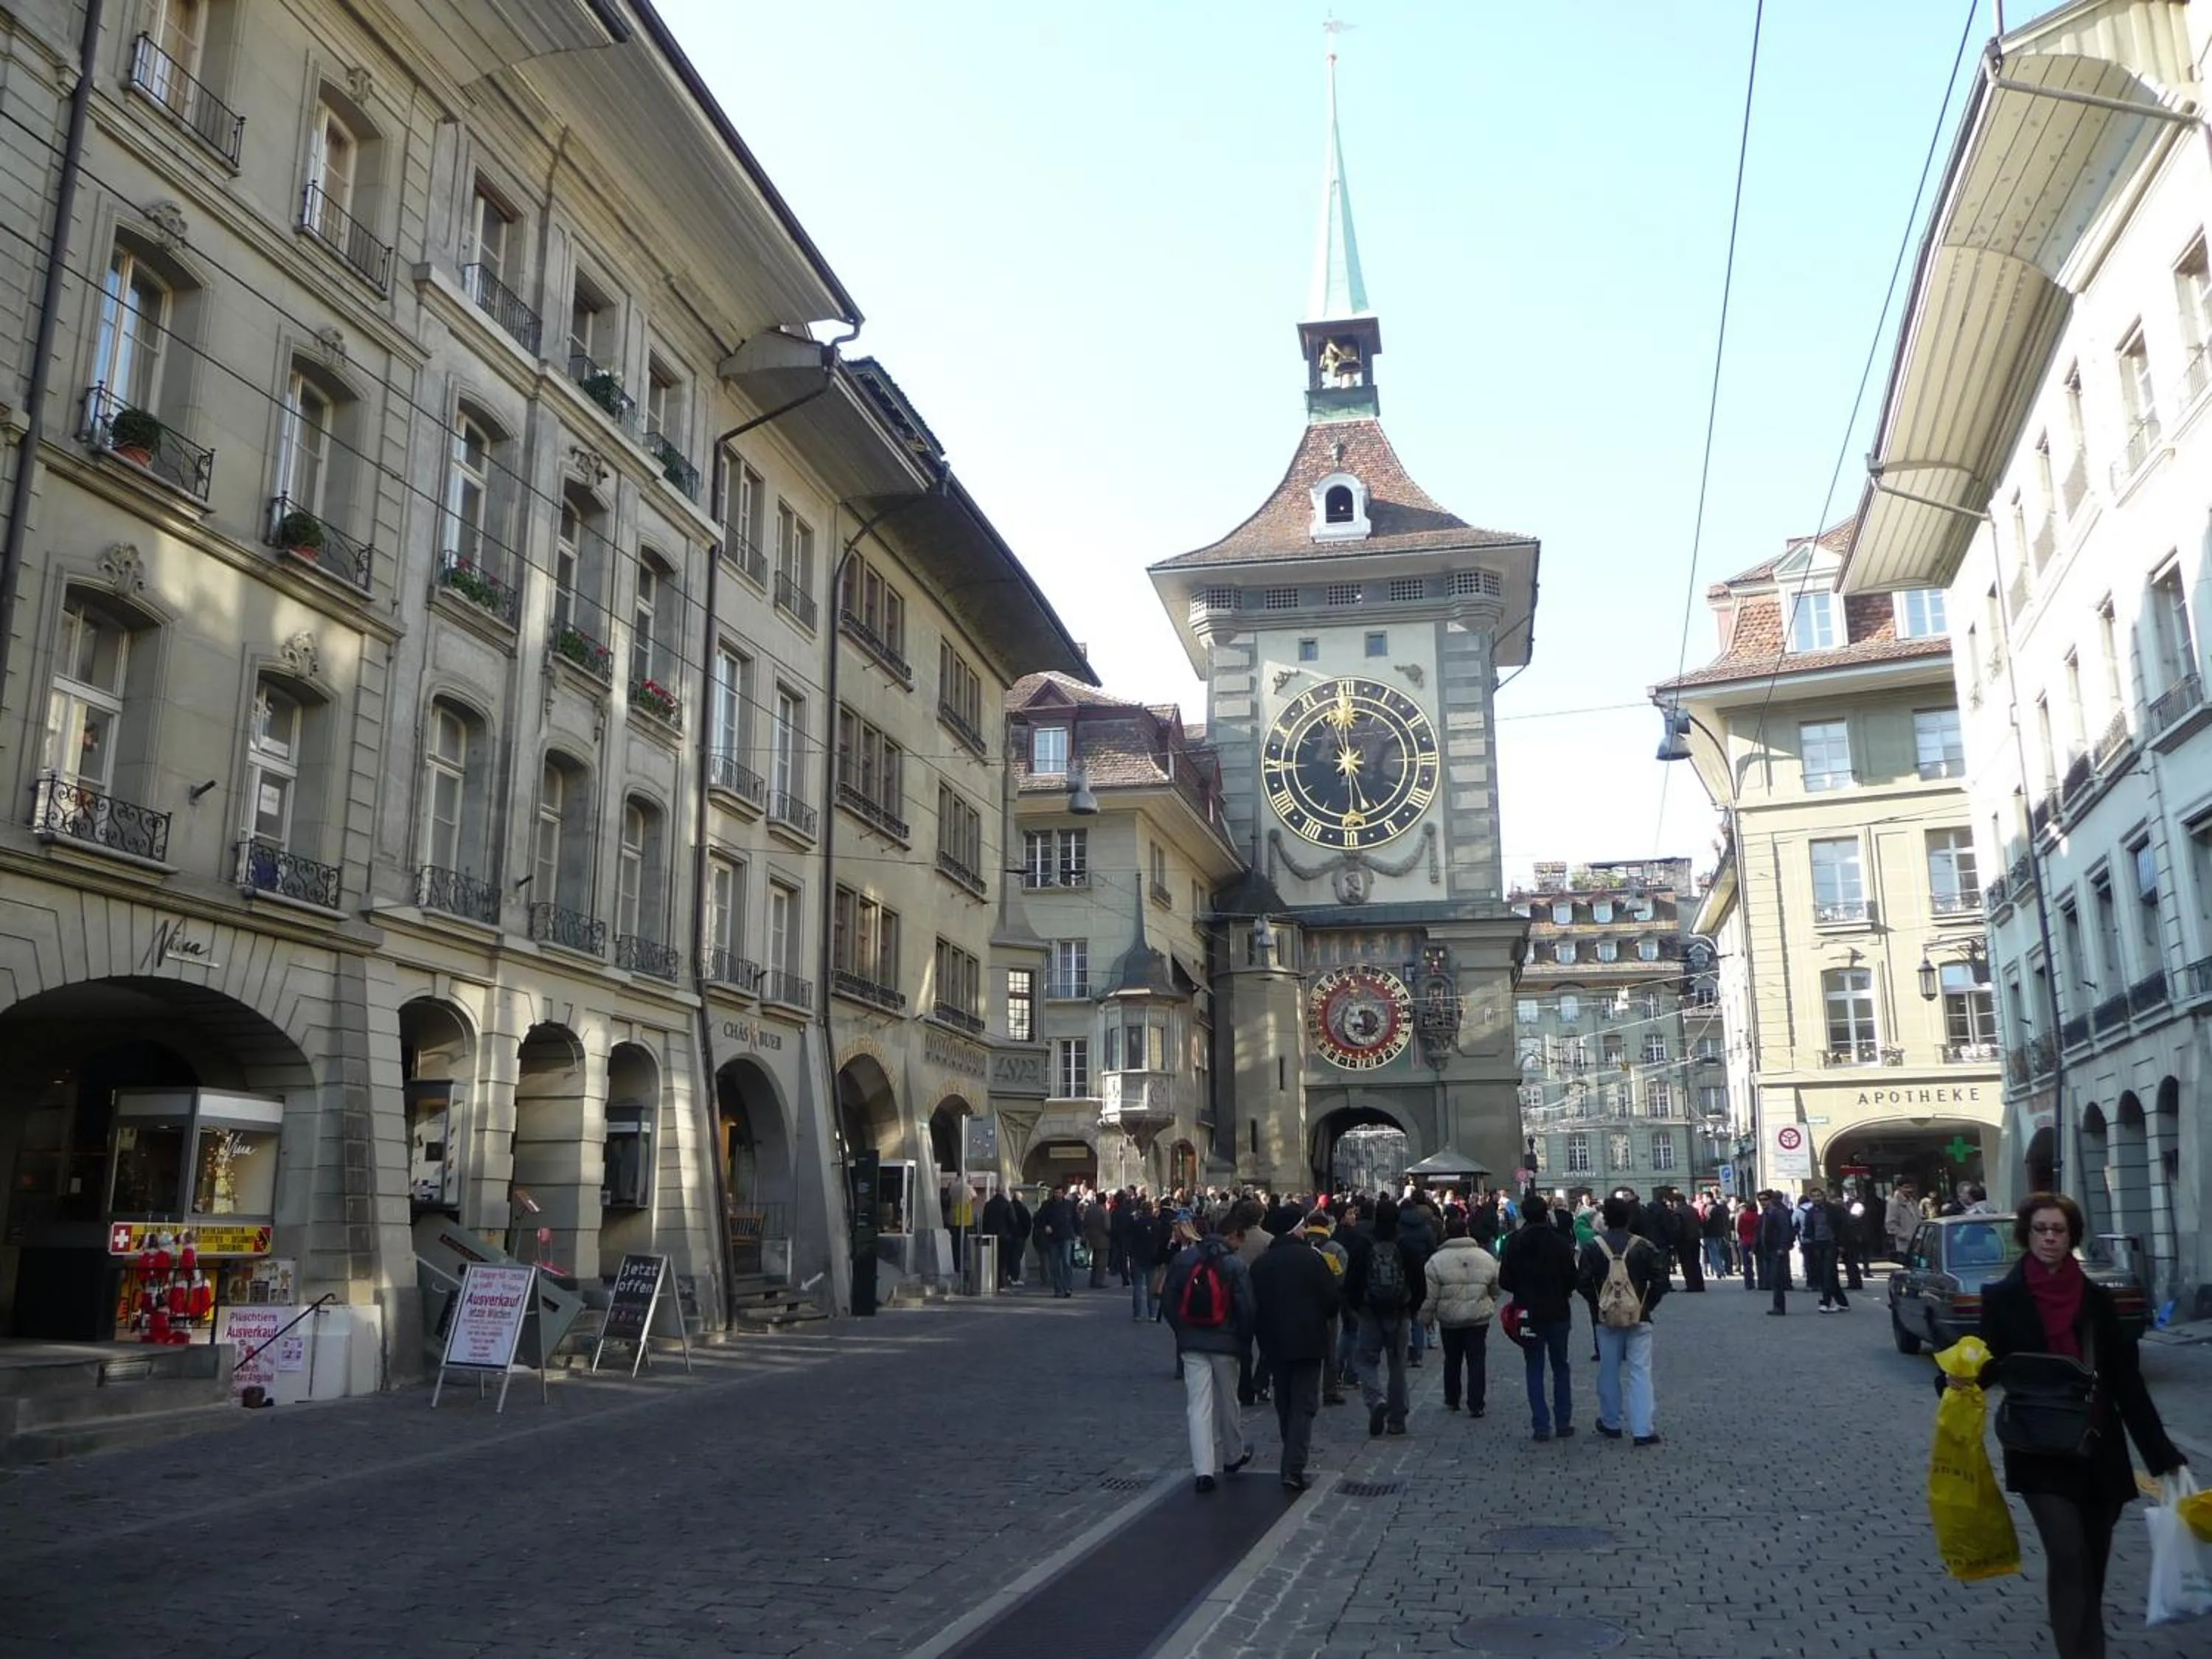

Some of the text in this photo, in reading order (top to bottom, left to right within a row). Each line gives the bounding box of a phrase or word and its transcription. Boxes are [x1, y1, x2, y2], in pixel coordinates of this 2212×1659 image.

[1857, 1088, 1980, 1105] APOTHEKE
[623, 1262, 658, 1276] jetzt
[619, 1279, 654, 1293] offen
[466, 1291, 522, 1307] Ausverkauf
[226, 1325, 278, 1338] Ausverkauf
